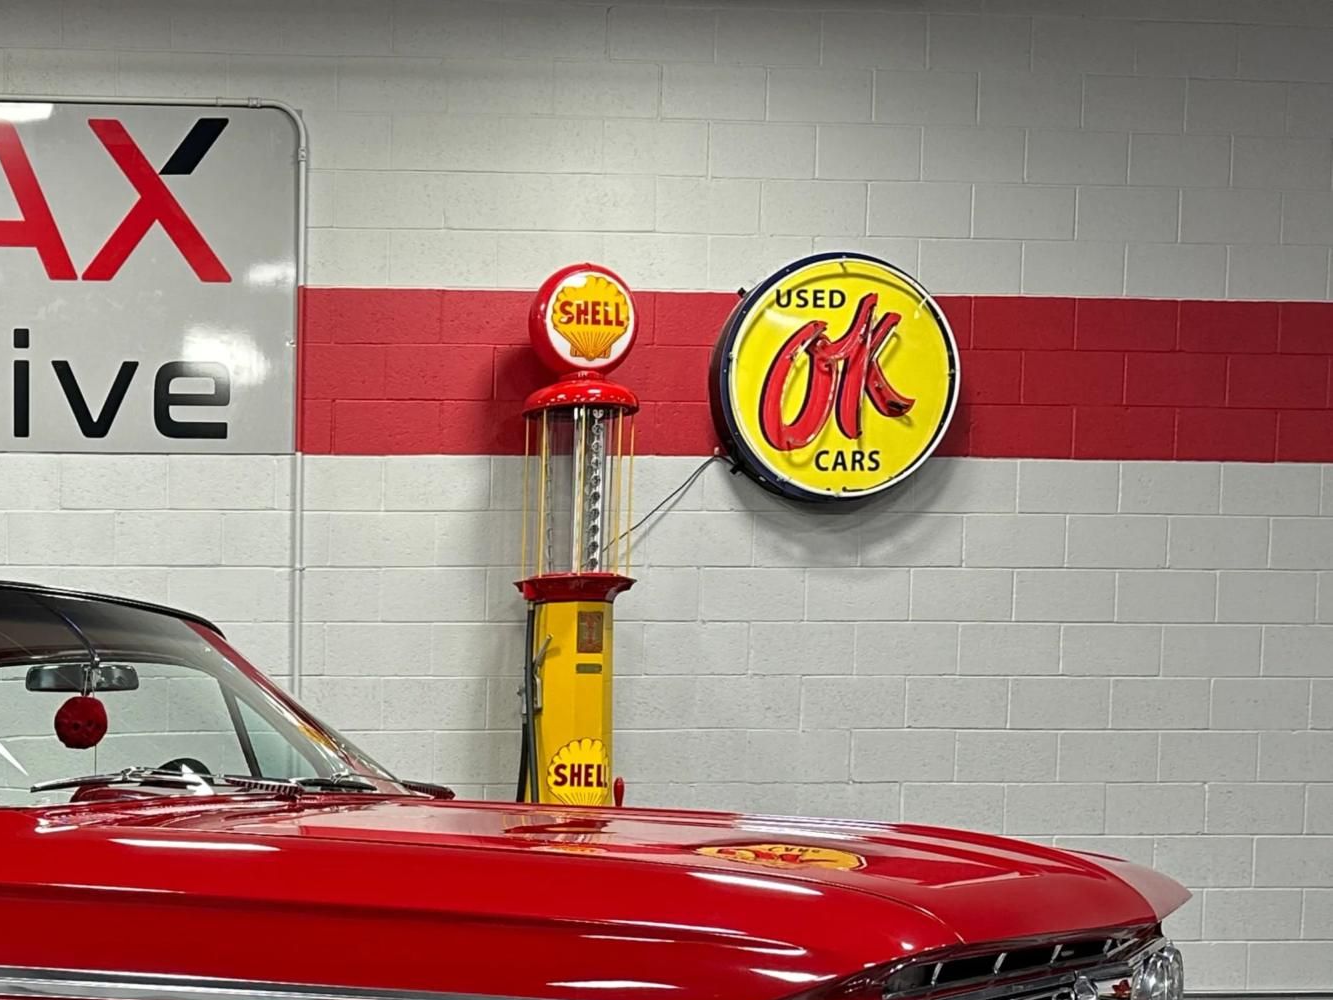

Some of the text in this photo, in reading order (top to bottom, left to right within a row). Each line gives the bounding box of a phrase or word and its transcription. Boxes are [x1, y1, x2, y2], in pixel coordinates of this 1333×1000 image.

[775, 289, 846, 308] USED
[558, 300, 624, 327] SHELL
[815, 450, 881, 471] CARS
